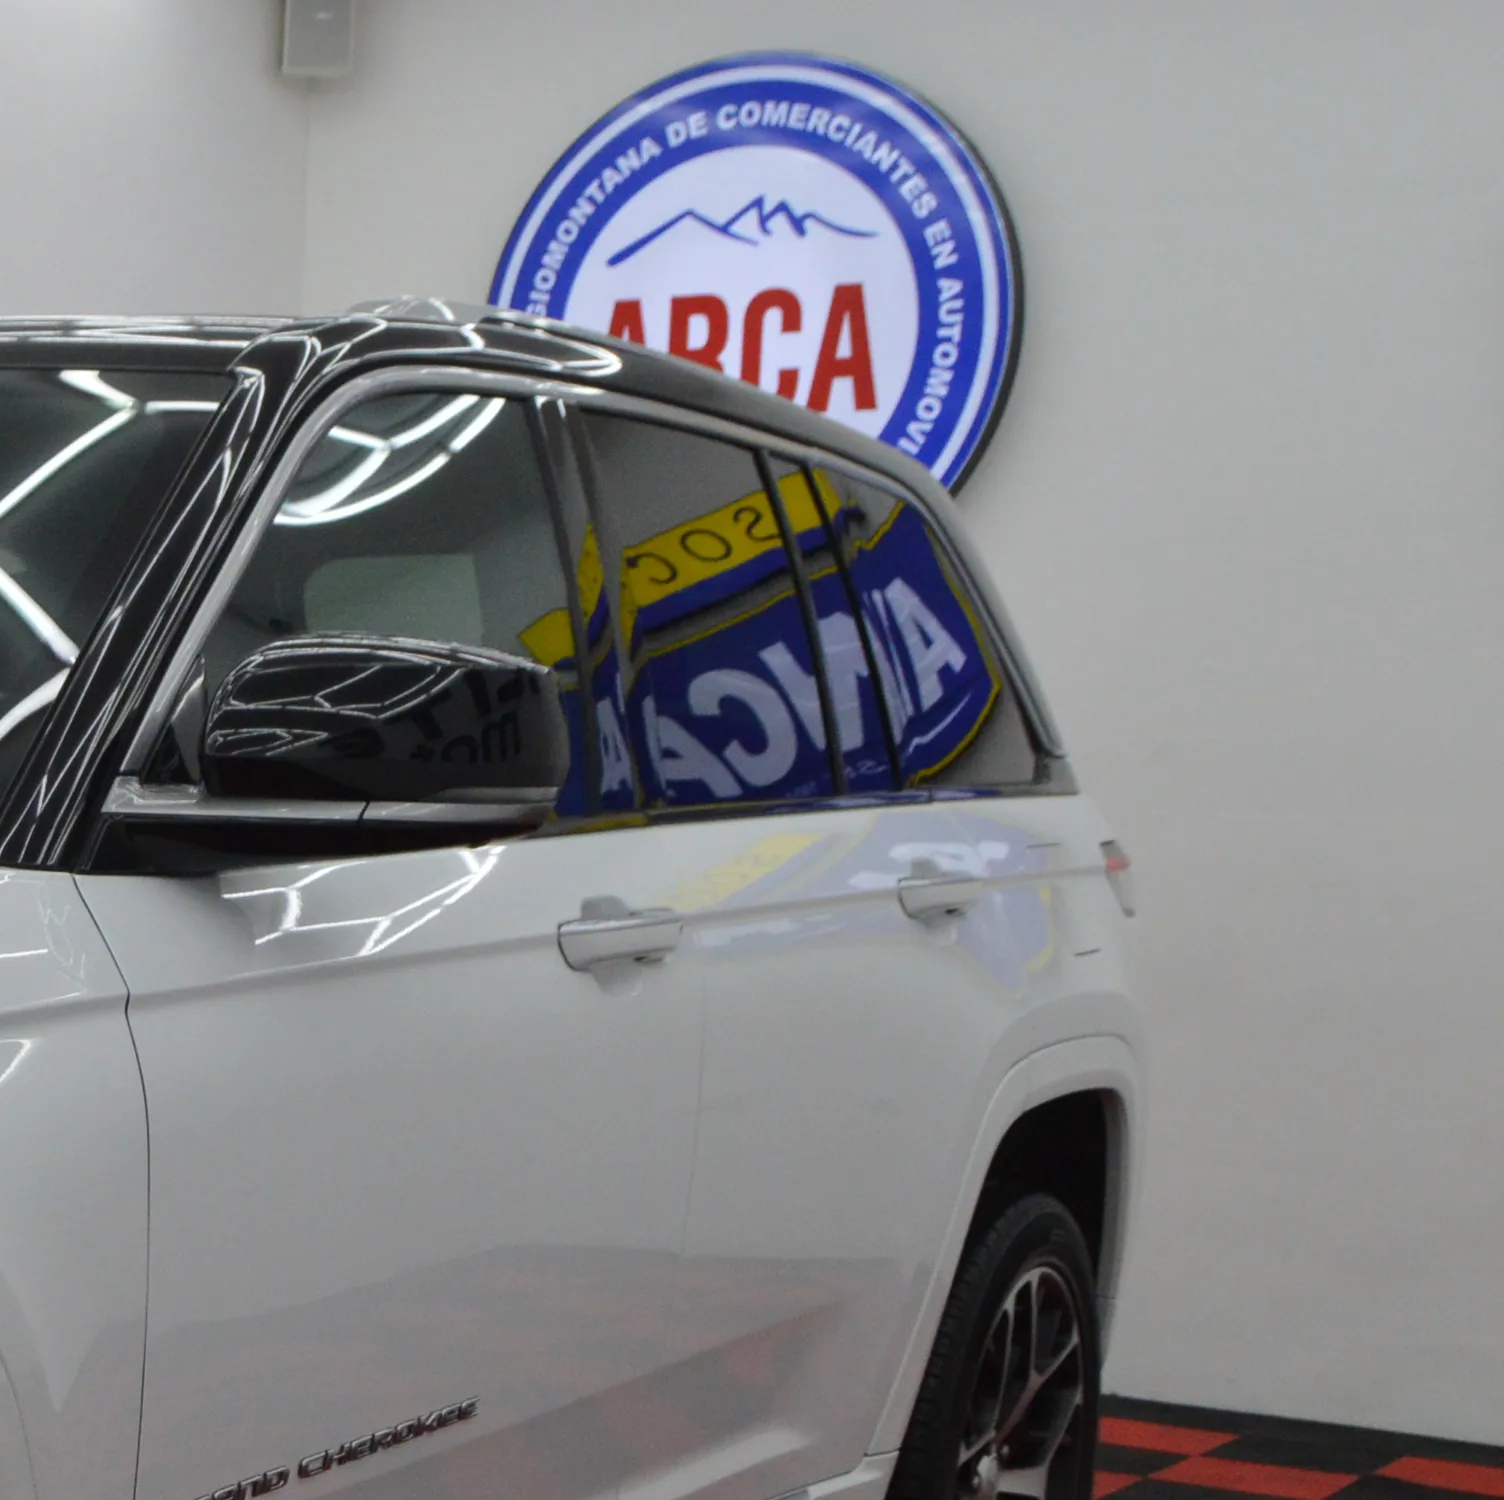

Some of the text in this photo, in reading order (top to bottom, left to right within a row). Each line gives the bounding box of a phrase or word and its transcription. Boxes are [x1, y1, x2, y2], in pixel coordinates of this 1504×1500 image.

[525, 100, 964, 455] GIOMONTANA DE COMERCIANTES EN AUTOMOVI
[297, 1395, 480, 1478] CHEROKEE
